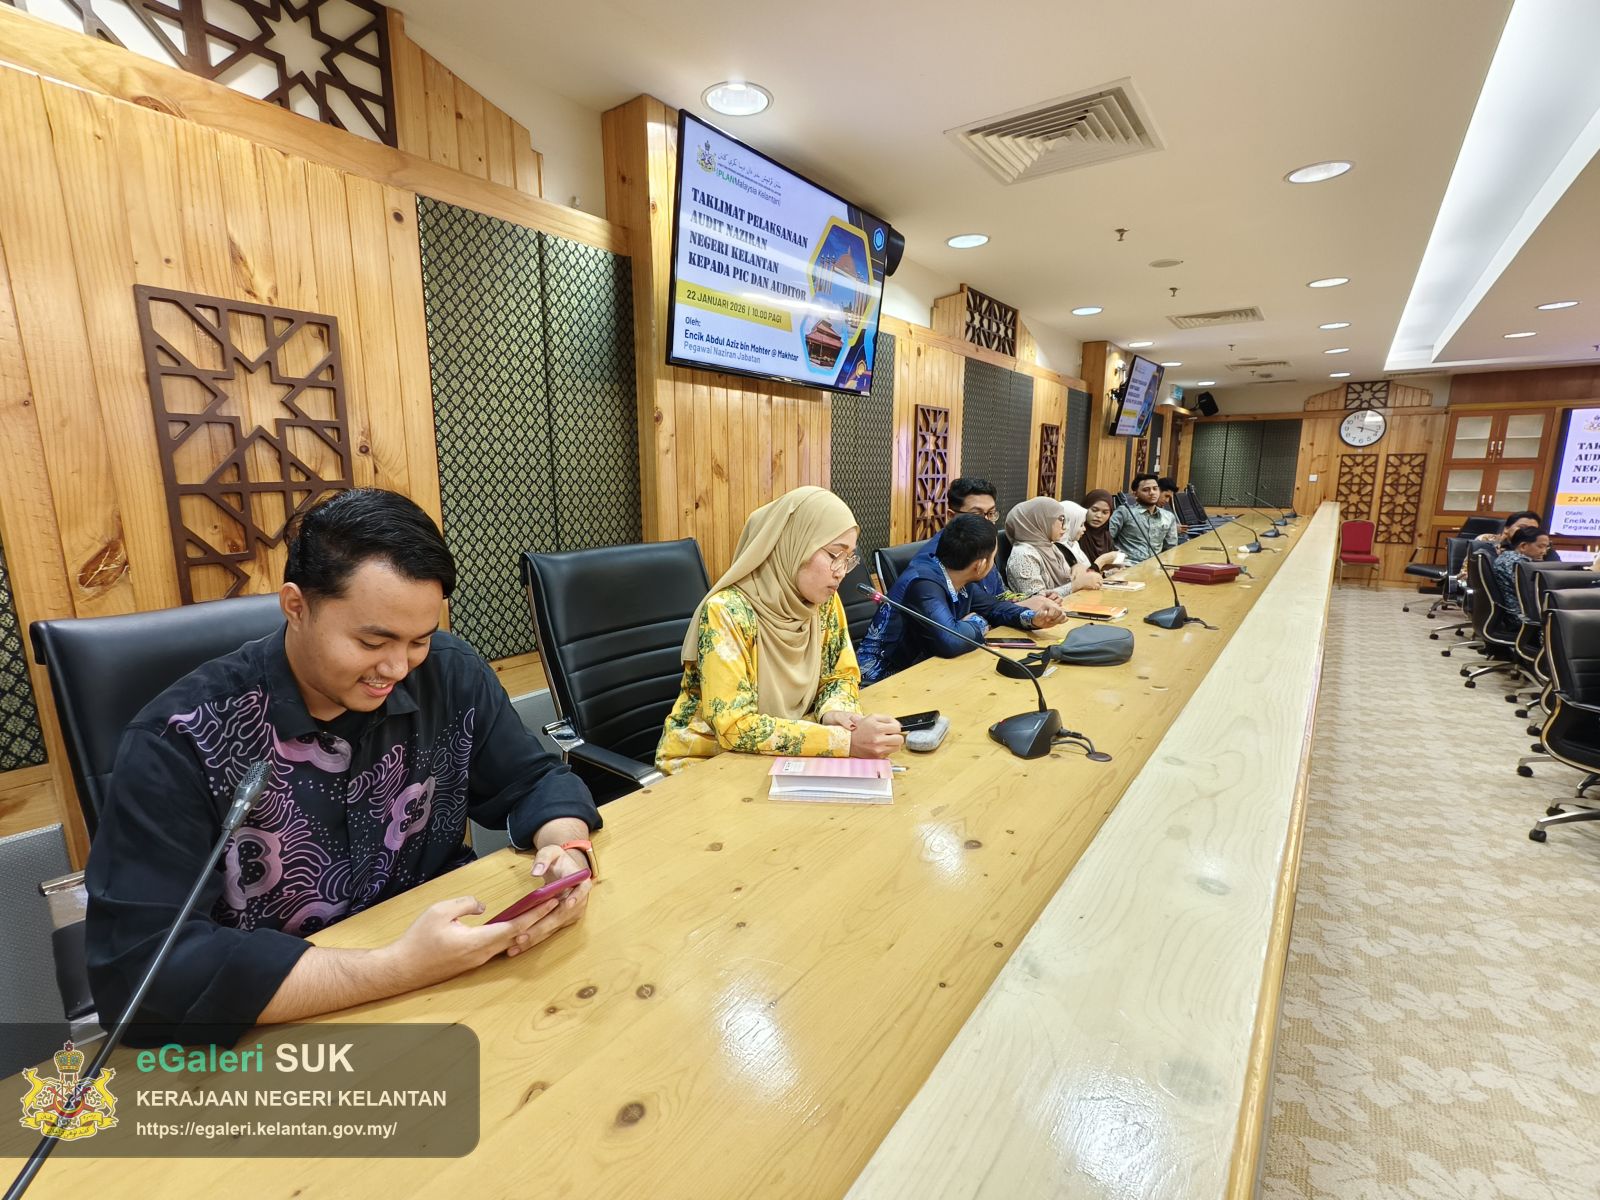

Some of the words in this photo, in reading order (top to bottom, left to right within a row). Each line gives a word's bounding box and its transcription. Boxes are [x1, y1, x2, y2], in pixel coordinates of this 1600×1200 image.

[690, 209, 725, 234] AUDIT
[726, 223, 768, 251] NAZIRAN
[691, 187, 746, 222] TAKLIMAT
[746, 211, 809, 249] PELAKSANAAN
[689, 230, 729, 256] NEGERI
[731, 245, 780, 274] KELANTAN
[688, 251, 730, 277] KEPADA
[732, 266, 749, 283] PIC
[751, 272, 769, 289] DAN
[771, 279, 807, 301] AUDITOR
[686, 289, 696, 301] 22
[697, 293, 729, 309] JANUARI
[729, 301, 746, 314] 2026
[752, 307, 768, 320] 10.00
[769, 310, 782, 324] PAGI
[685, 316, 701, 327] Oleh:
[683, 341, 713, 354] Pegawai
[713, 346, 737, 359] Naziran
[737, 351, 761, 364] Jabatan
[684, 329, 704, 341] Encik
[705, 333, 725, 346] Abdul
[726, 338, 739, 350] Aziz
[740, 341, 750, 351] bin
[1571, 476, 1600, 484] KEP
[1573, 464, 1600, 472] NEG
